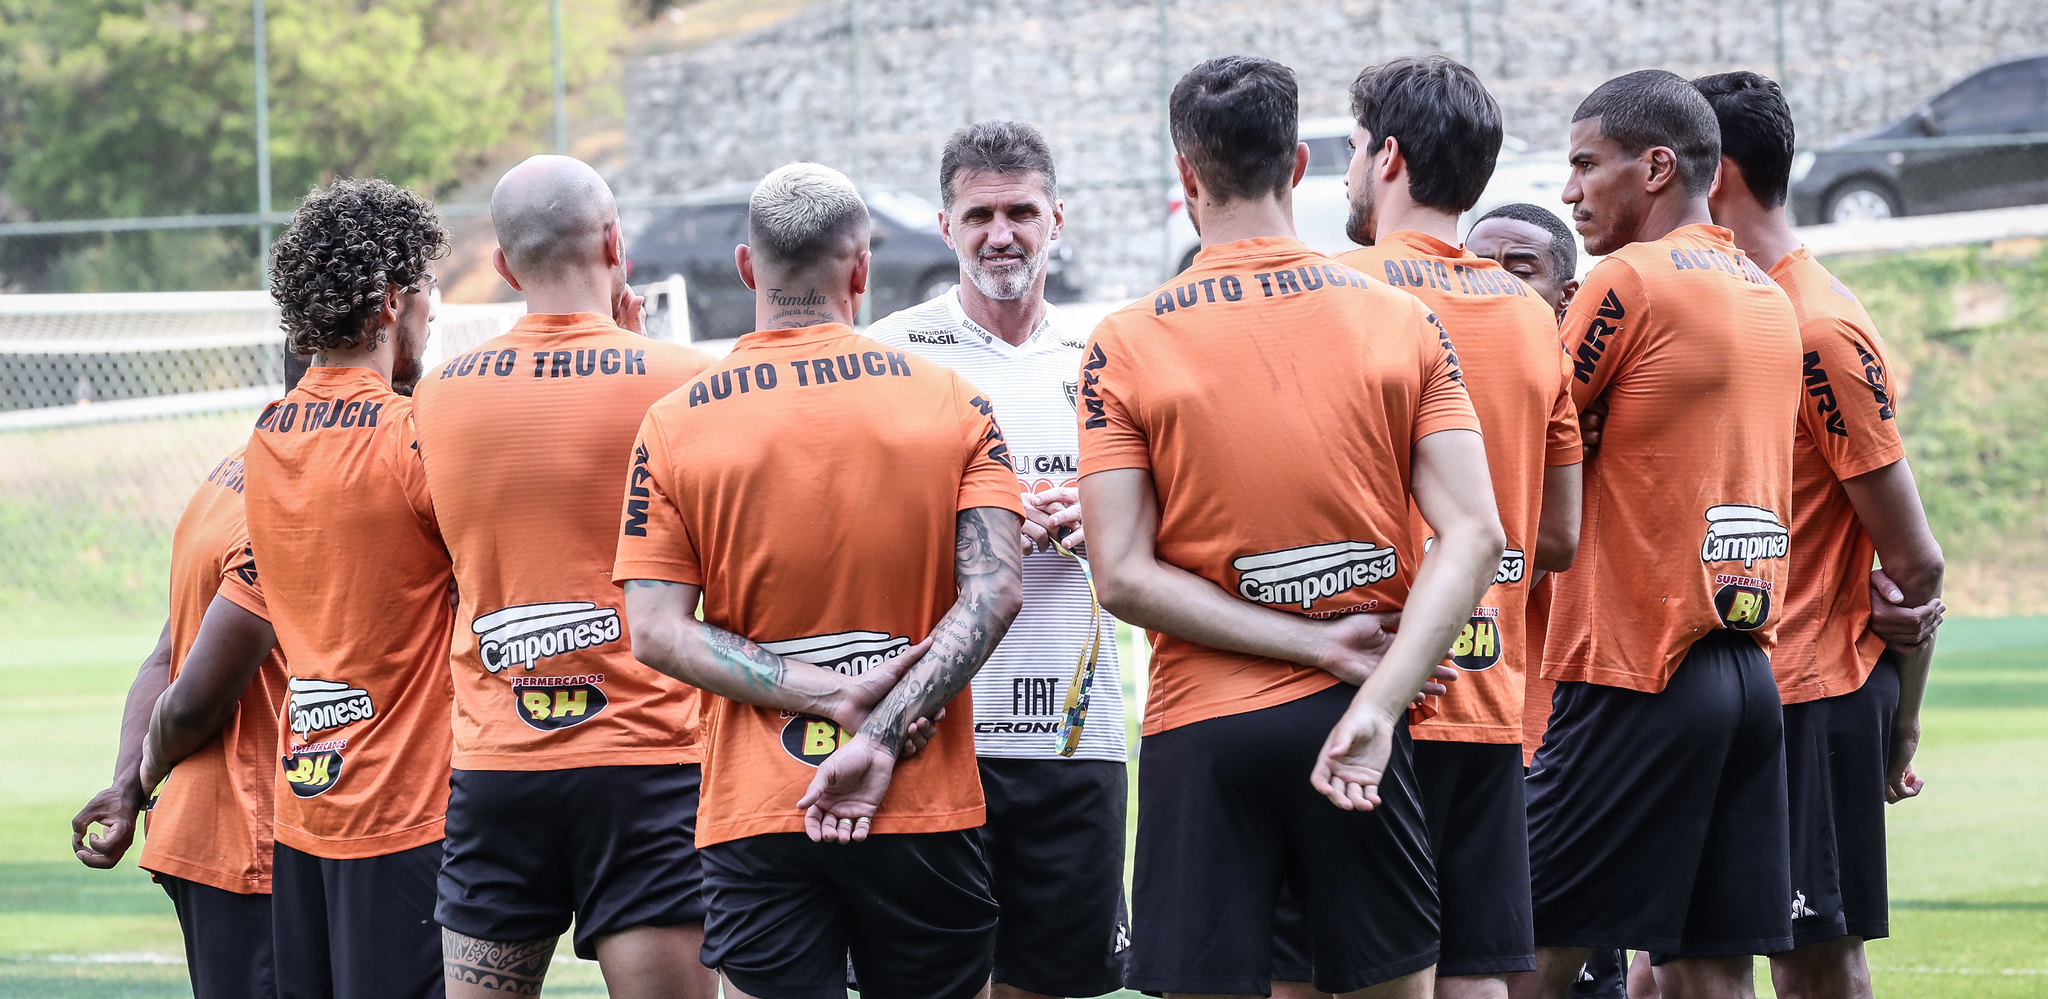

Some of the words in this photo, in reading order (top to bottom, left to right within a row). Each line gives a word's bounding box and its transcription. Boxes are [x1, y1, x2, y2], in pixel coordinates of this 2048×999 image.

[1384, 259, 1451, 291] AUTO
[1454, 264, 1528, 297] TRUCK
[1671, 249, 1736, 275] AUTO
[1155, 275, 1243, 316] AUTO
[1254, 265, 1369, 297] TRUCK
[909, 333, 959, 345] BRASIL
[1573, 288, 1626, 385] MRV
[440, 349, 517, 380] AUTO
[532, 348, 647, 378] TRUCK
[688, 362, 778, 408] AUTO
[790, 350, 912, 387] TRUCK
[1082, 341, 1108, 431] MRV
[1802, 350, 1849, 438] MRV
[255, 402, 299, 433] UTO
[302, 398, 383, 433] TRUCK
[1034, 454, 1080, 474] GAL
[624, 438, 652, 537] MRV
[1239, 553, 1397, 609] Camponesa
[480, 616, 621, 673] Camponesa
[1452, 621, 1495, 657] BH
[510, 674, 604, 687] UPERMERCADOS
[1012, 677, 1059, 716] FIAT
[288, 696, 374, 741] Caponesa
[522, 689, 588, 721] BH
[975, 722, 1059, 734] CRON
[285, 753, 332, 786] BH
